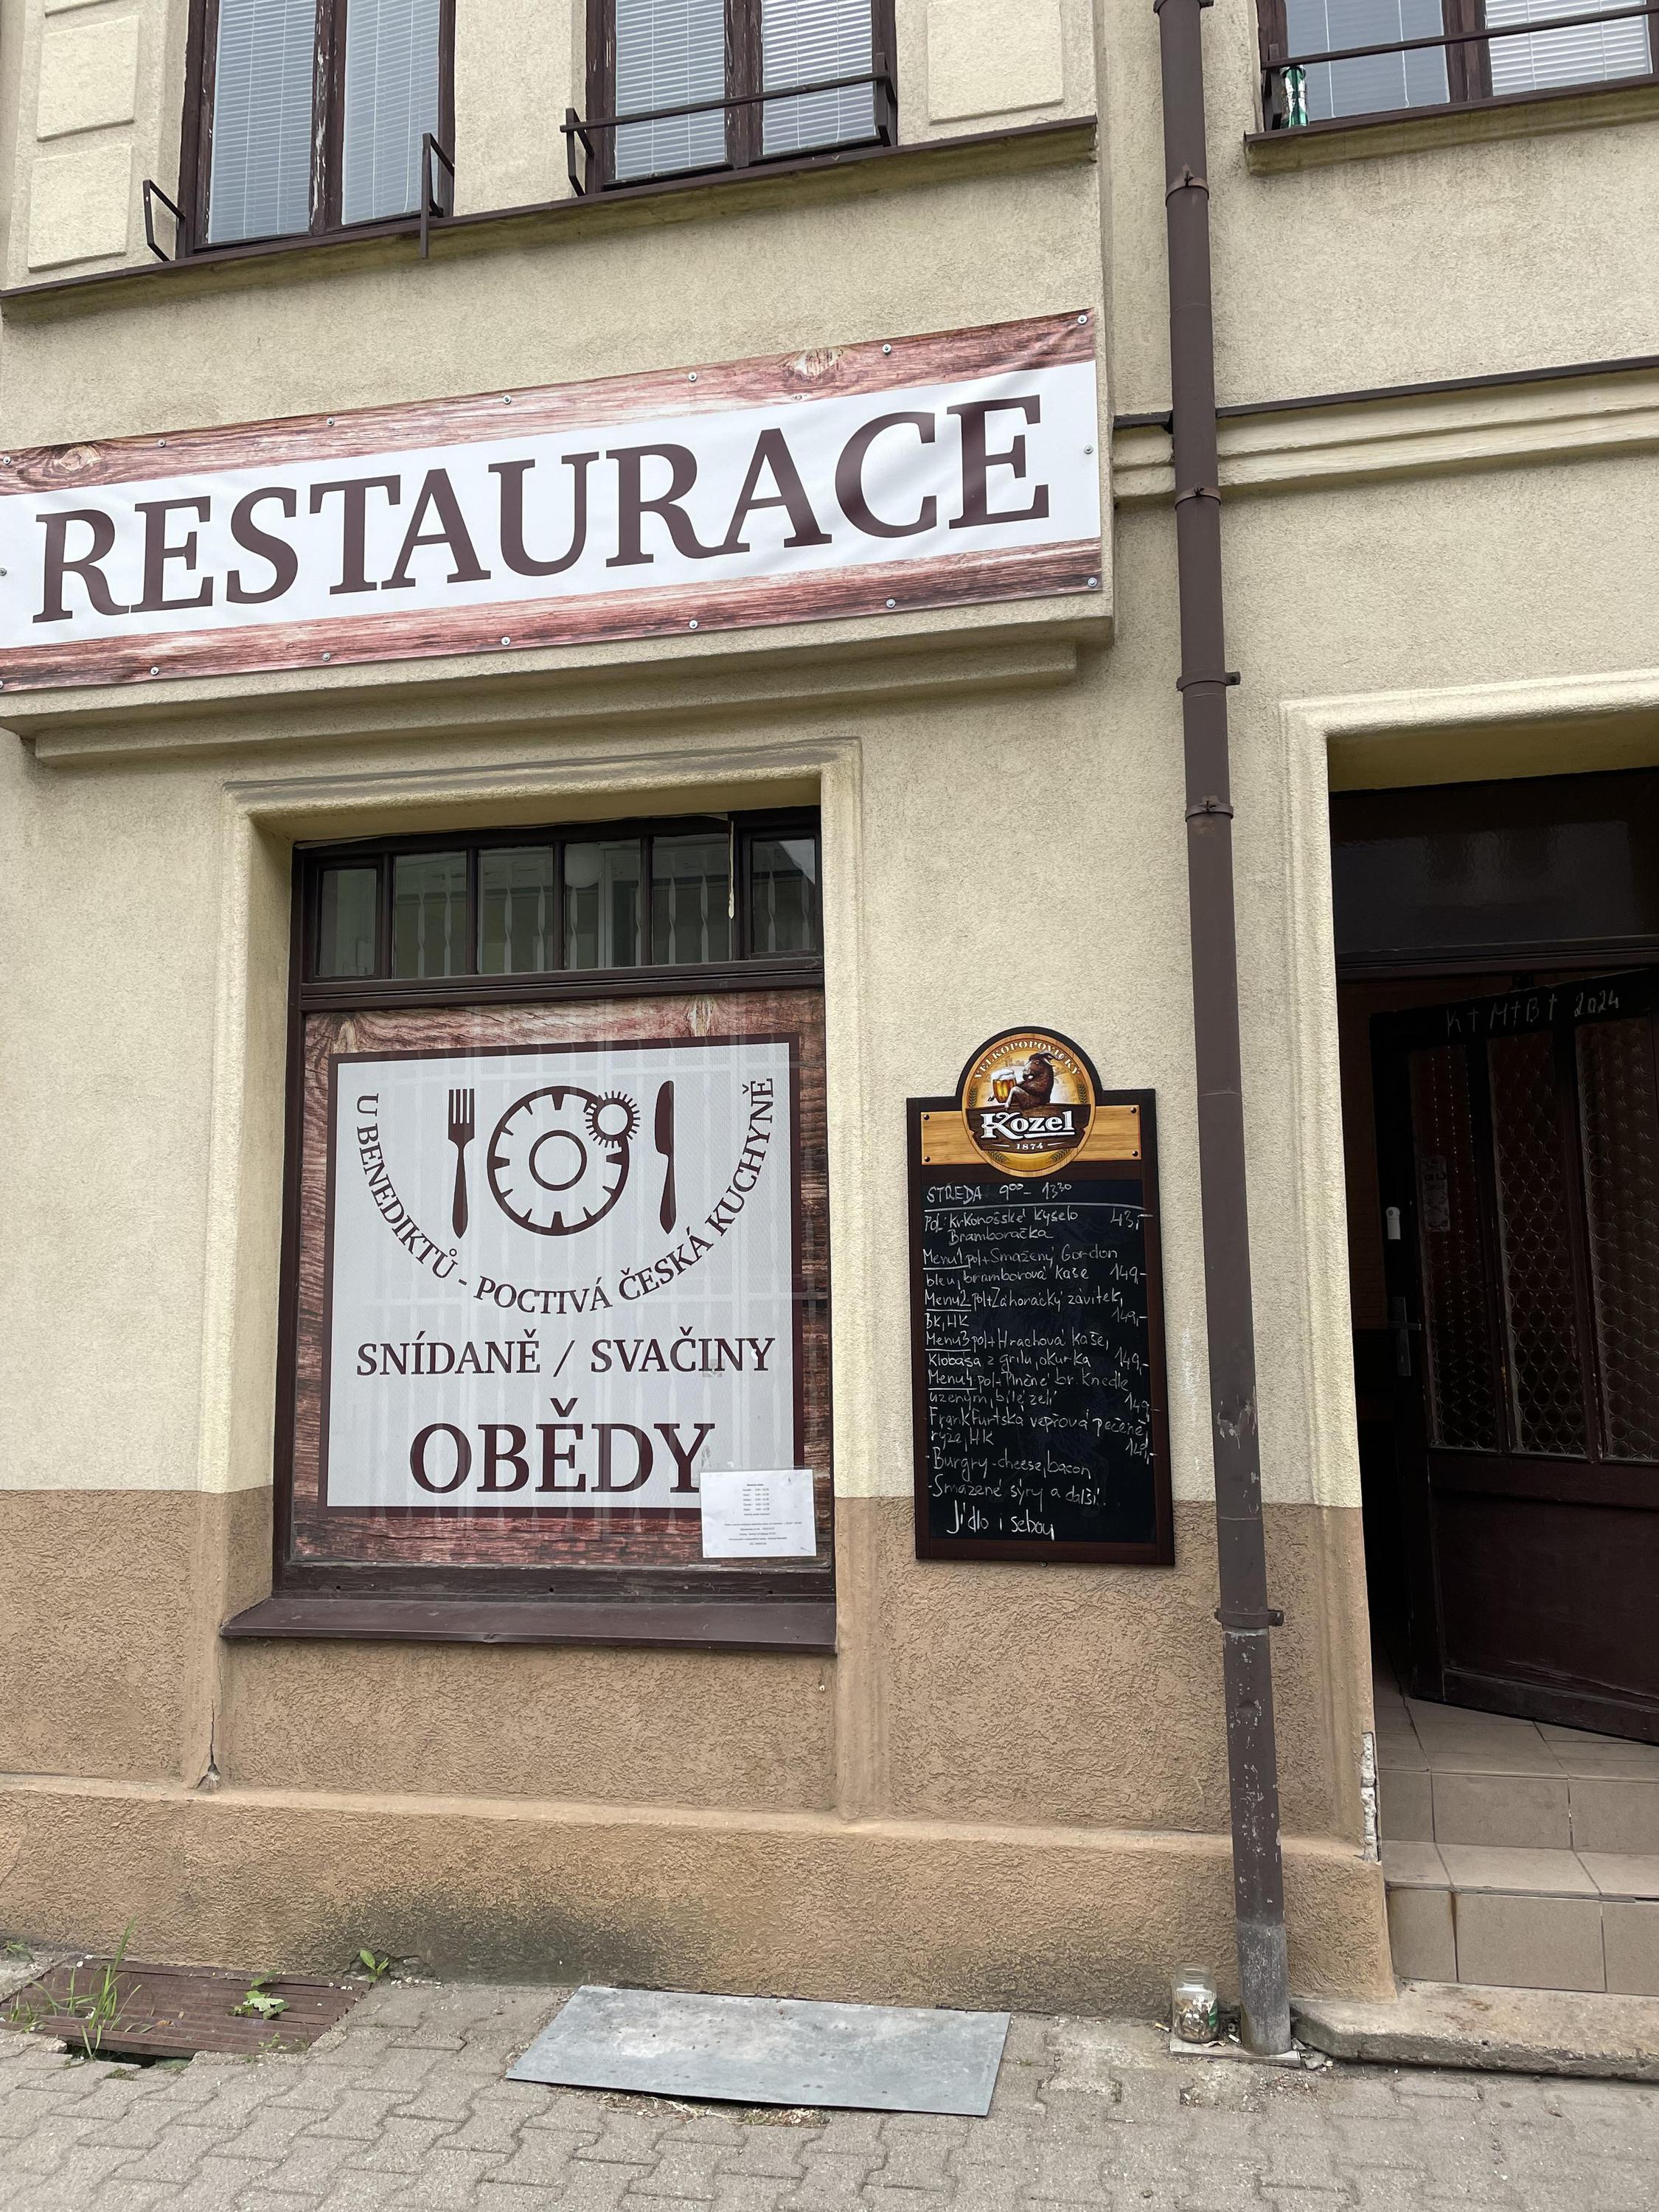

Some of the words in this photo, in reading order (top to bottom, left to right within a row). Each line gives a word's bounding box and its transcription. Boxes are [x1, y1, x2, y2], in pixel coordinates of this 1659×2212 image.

[32, 394, 1049, 623] RESTAURACE
[1573, 990, 1619, 1018] 2024
[357, 1093, 378, 1116] U
[980, 1110, 1075, 1140] Kozel
[706, 1077, 775, 1235] KUCHYNĚ
[1016, 1142, 1043, 1150] 1874
[357, 1126, 459, 1279] BENEDIKTŮ
[926, 1182, 982, 1205] STŘEDA
[618, 1227, 713, 1300] ČESKÁ
[1061, 1243, 1118, 1262] Gordon
[473, 1267, 613, 1314] POCTIVÁ
[963, 1267, 1047, 1284] bramborová
[357, 1329, 540, 1376] SNÍDANĚ
[553, 1340, 575, 1378] /
[590, 1326, 775, 1373] SVAČINY
[409, 1397, 715, 1494] OBĚDY
[1010, 1478, 1043, 1512] sýry
[1051, 1488, 1061, 1498] a
[947, 1500, 989, 1534] Jídlo
